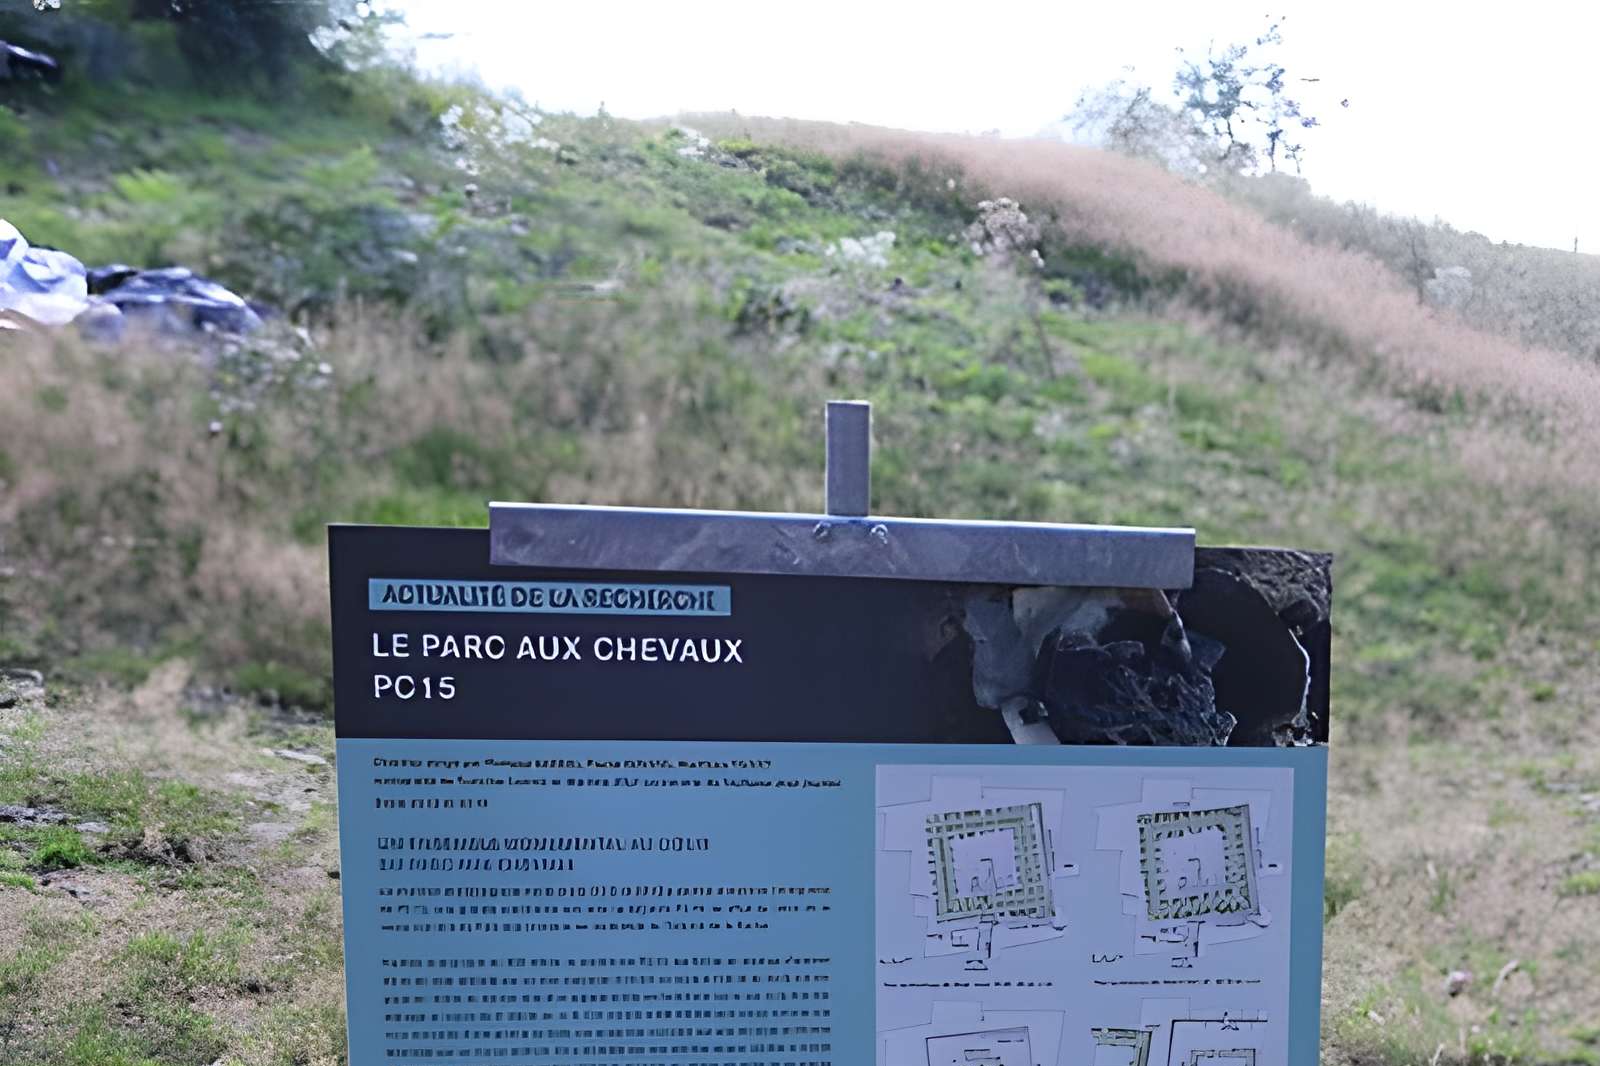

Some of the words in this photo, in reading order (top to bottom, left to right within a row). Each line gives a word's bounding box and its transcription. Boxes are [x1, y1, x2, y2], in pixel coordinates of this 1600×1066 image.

[372, 632, 410, 657] LE
[422, 633, 506, 660] PARC
[516, 635, 582, 661] AUX
[593, 637, 744, 663] CHEVAUX
